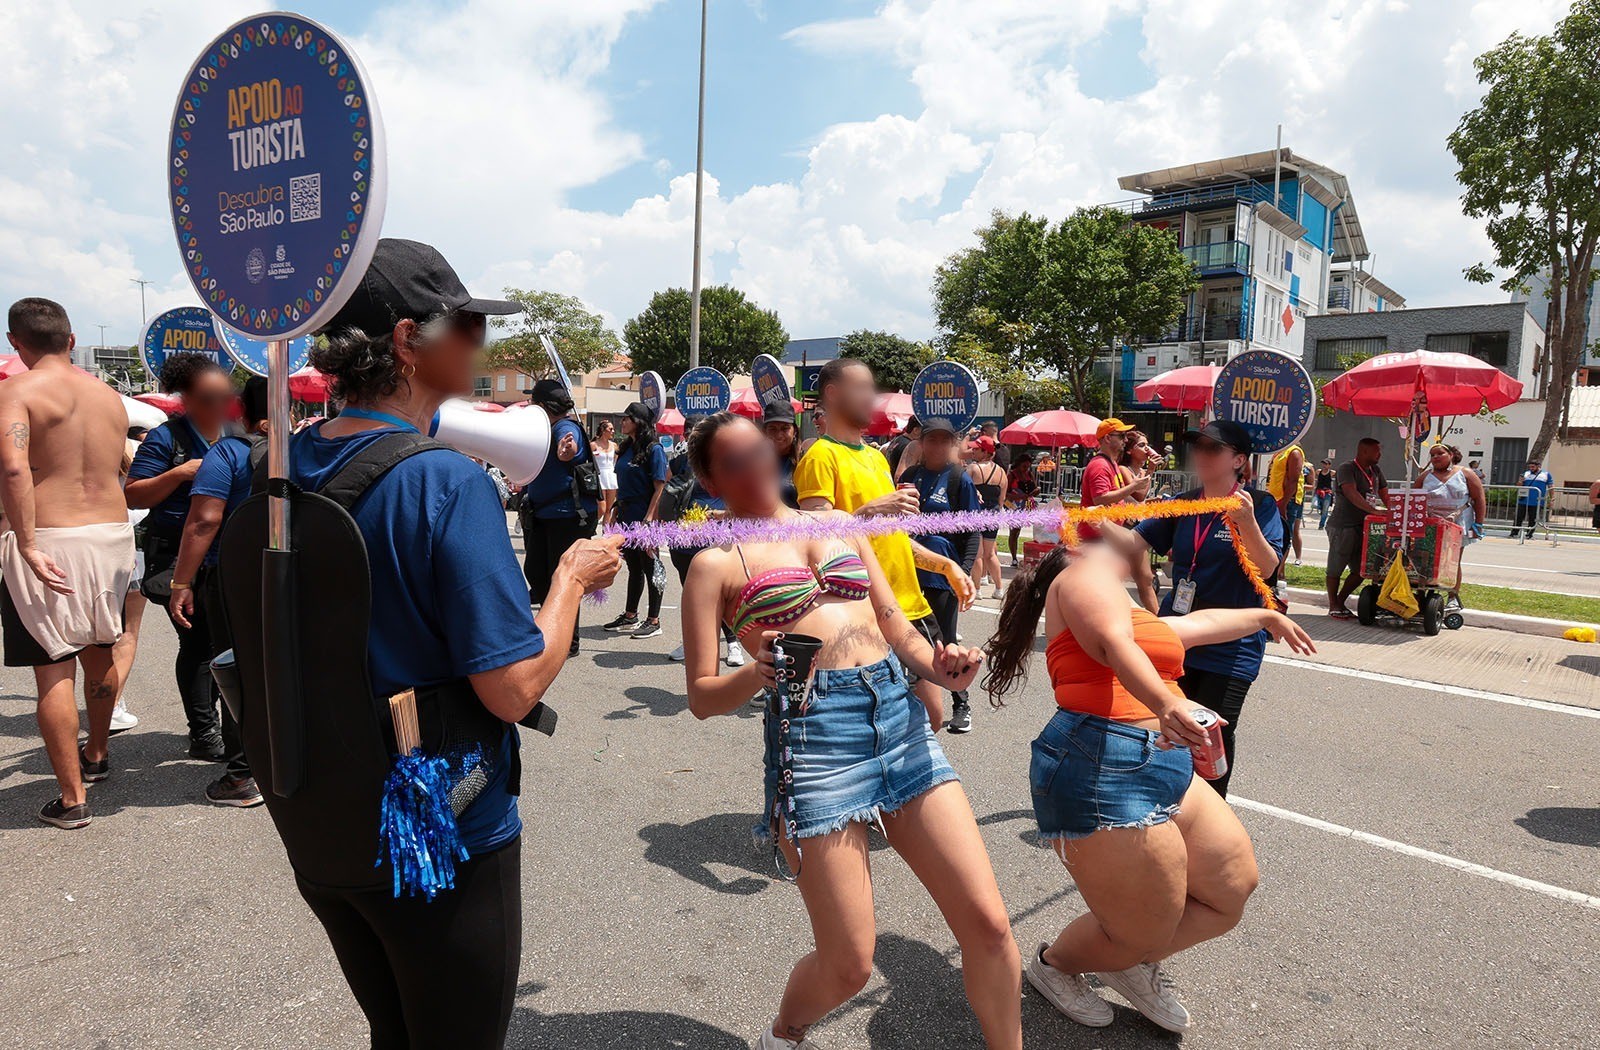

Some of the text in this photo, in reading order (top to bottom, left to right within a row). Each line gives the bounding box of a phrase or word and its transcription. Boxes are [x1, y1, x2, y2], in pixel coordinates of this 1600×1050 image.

[228, 78, 303, 129] APOIO AO
[228, 118, 305, 171] TURISTA
[218, 183, 284, 212] Descubra
[220, 204, 285, 234] São Paulo
[162, 328, 207, 349] APOIO
[685, 383, 711, 396] APOIO
[685, 396, 720, 410] TURISTA
[924, 382, 954, 399] APOIO
[1230, 376, 1293, 405] APOIO AO
[924, 398, 966, 415] TURISTA
[1230, 399, 1289, 428] TURISTA
